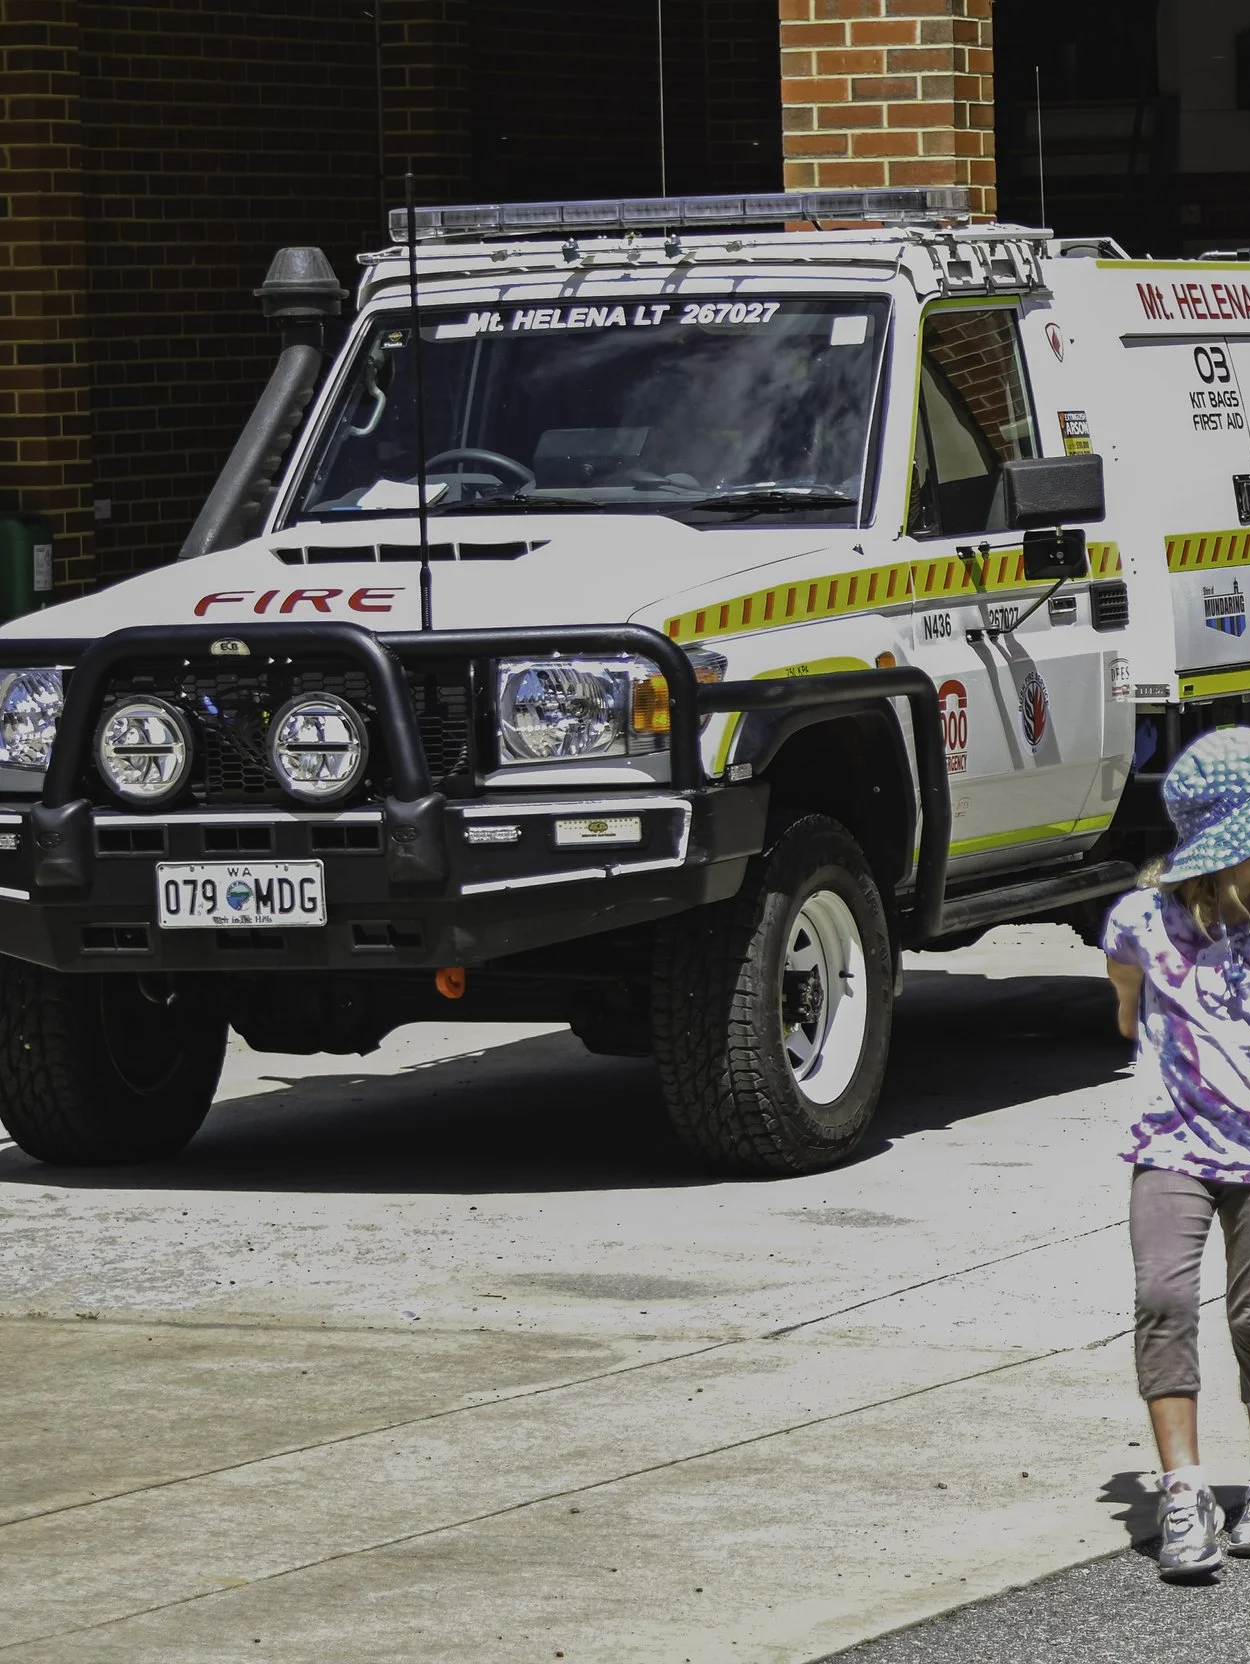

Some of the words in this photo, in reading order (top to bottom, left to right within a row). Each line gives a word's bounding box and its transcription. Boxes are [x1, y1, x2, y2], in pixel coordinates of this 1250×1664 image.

[1136, 283, 1175, 320] Mt.
[511, 306, 627, 331] HELENA
[633, 304, 670, 327] LT
[680, 302, 781, 325] 267027
[1193, 346, 1231, 384] 03
[1189, 391, 1206, 409] KIT
[1208, 390, 1240, 408] BAGS
[1066, 421, 1090, 435] ARSON
[1192, 413, 1223, 431] FIRST
[1226, 412, 1244, 430] AID
[194, 587, 406, 617] FIRE
[1204, 595, 1245, 617] MUNDARING
[923, 613, 952, 640] N436
[989, 607, 1019, 631] 267027
[165, 879, 217, 915] 079
[254, 877, 317, 915] MDG
